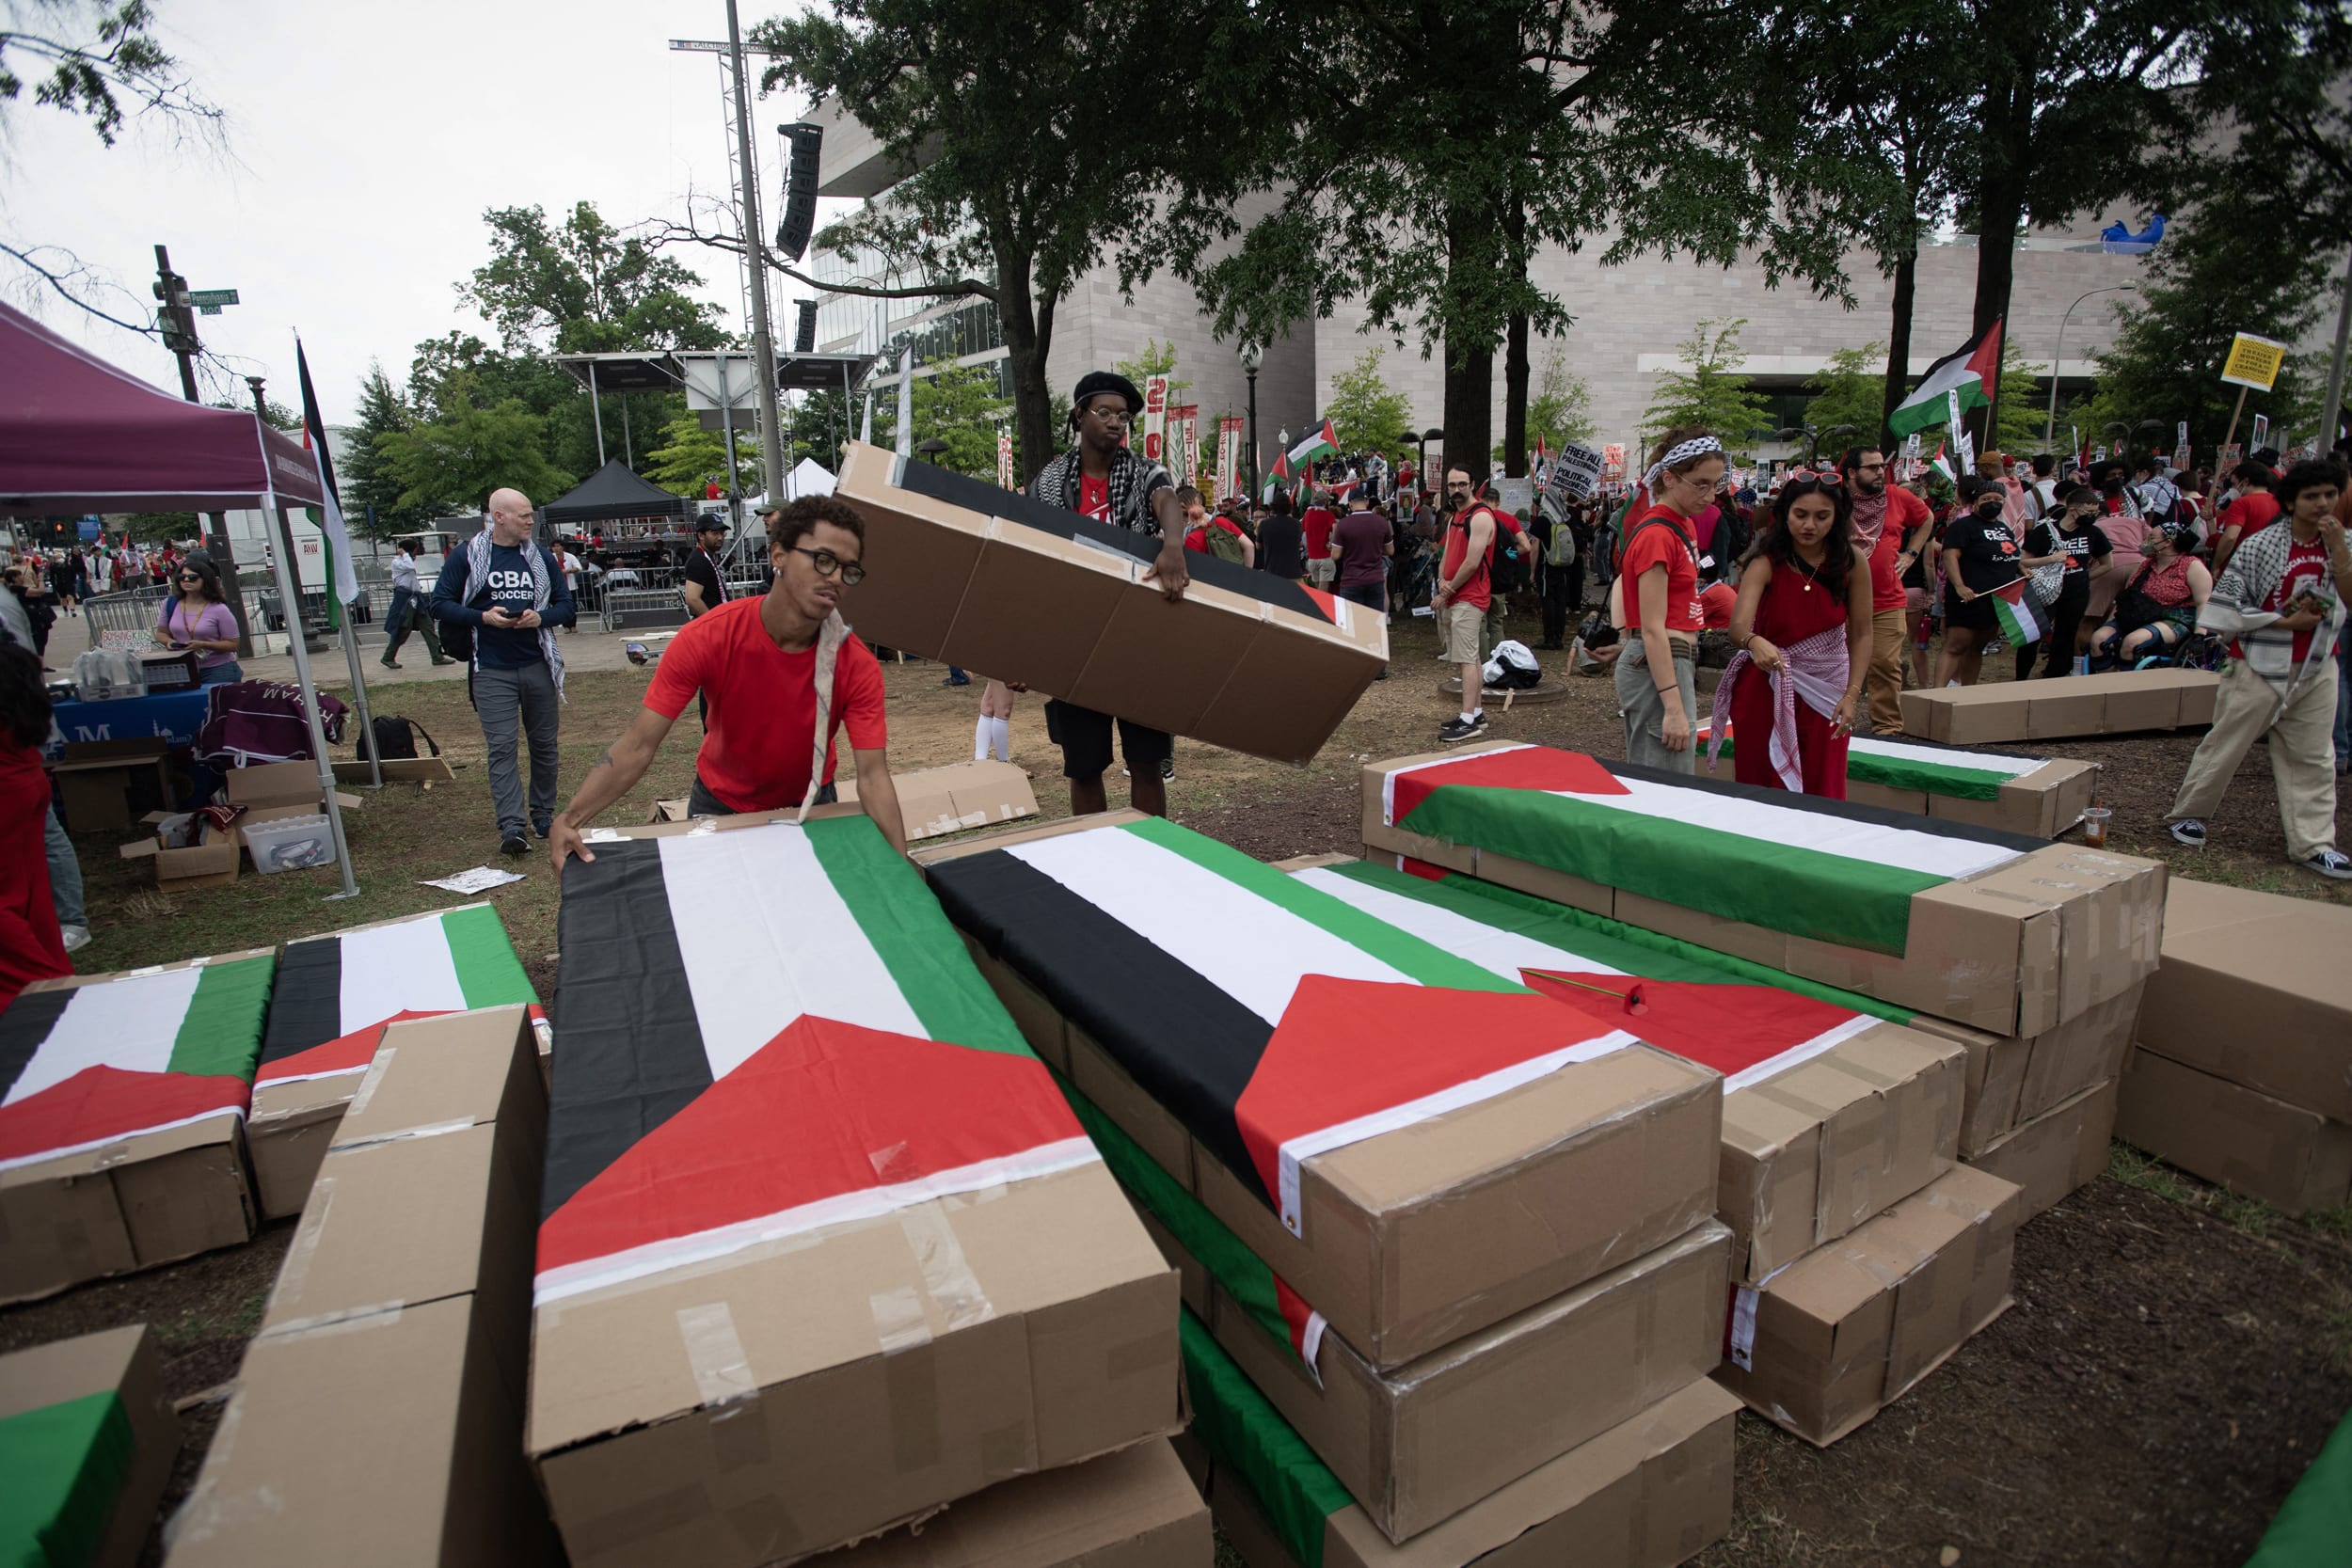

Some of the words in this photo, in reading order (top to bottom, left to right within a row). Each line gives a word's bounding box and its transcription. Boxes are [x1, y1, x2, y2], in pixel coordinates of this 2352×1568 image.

[1562, 454, 1599, 475] PALESTINIAN
[1565, 444, 1587, 461] FREE
[1586, 453, 1601, 467] ALL
[1552, 475, 1589, 495] PRISONERS
[1556, 467, 1592, 487] POLITICAL
[487, 571, 534, 589] CBA
[491, 591, 534, 600] SOCCER
